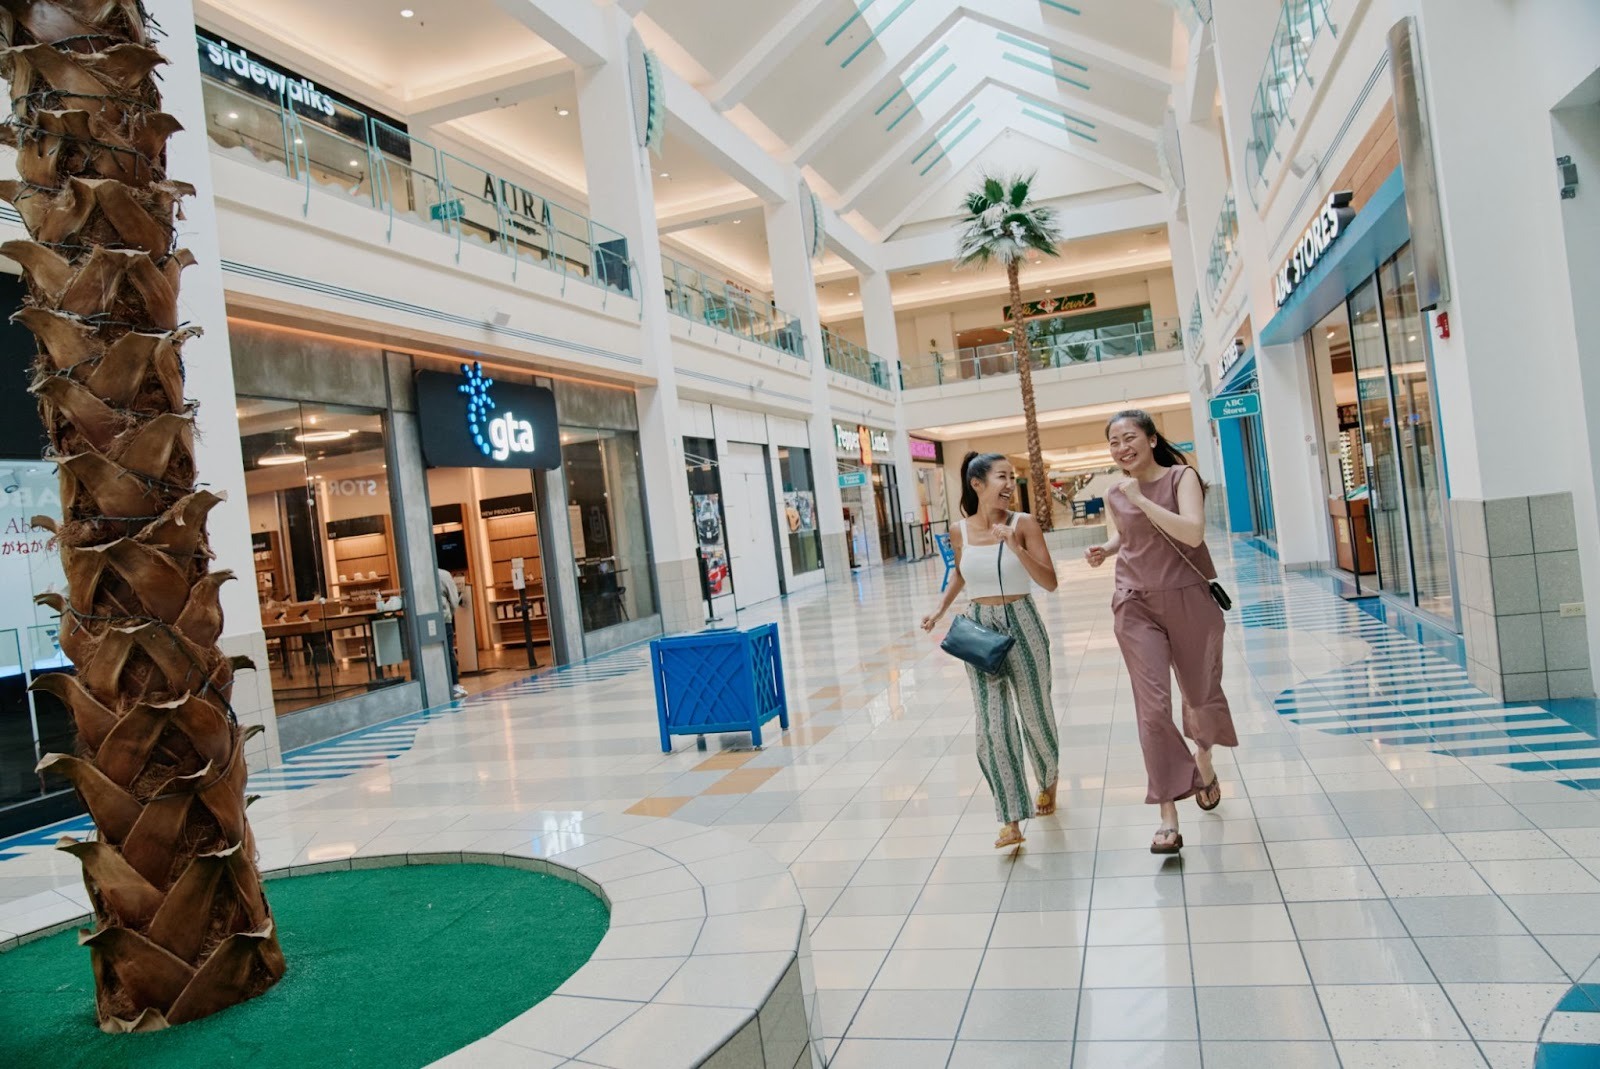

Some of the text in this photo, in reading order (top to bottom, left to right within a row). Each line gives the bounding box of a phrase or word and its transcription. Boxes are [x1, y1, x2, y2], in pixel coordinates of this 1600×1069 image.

[207, 40, 335, 116] sidewalks
[484, 174, 550, 226] AURA
[1293, 192, 1339, 283] STORES
[1223, 406, 1246, 416] Stores
[1224, 398, 1243, 408] ABC
[489, 411, 535, 461] gta
